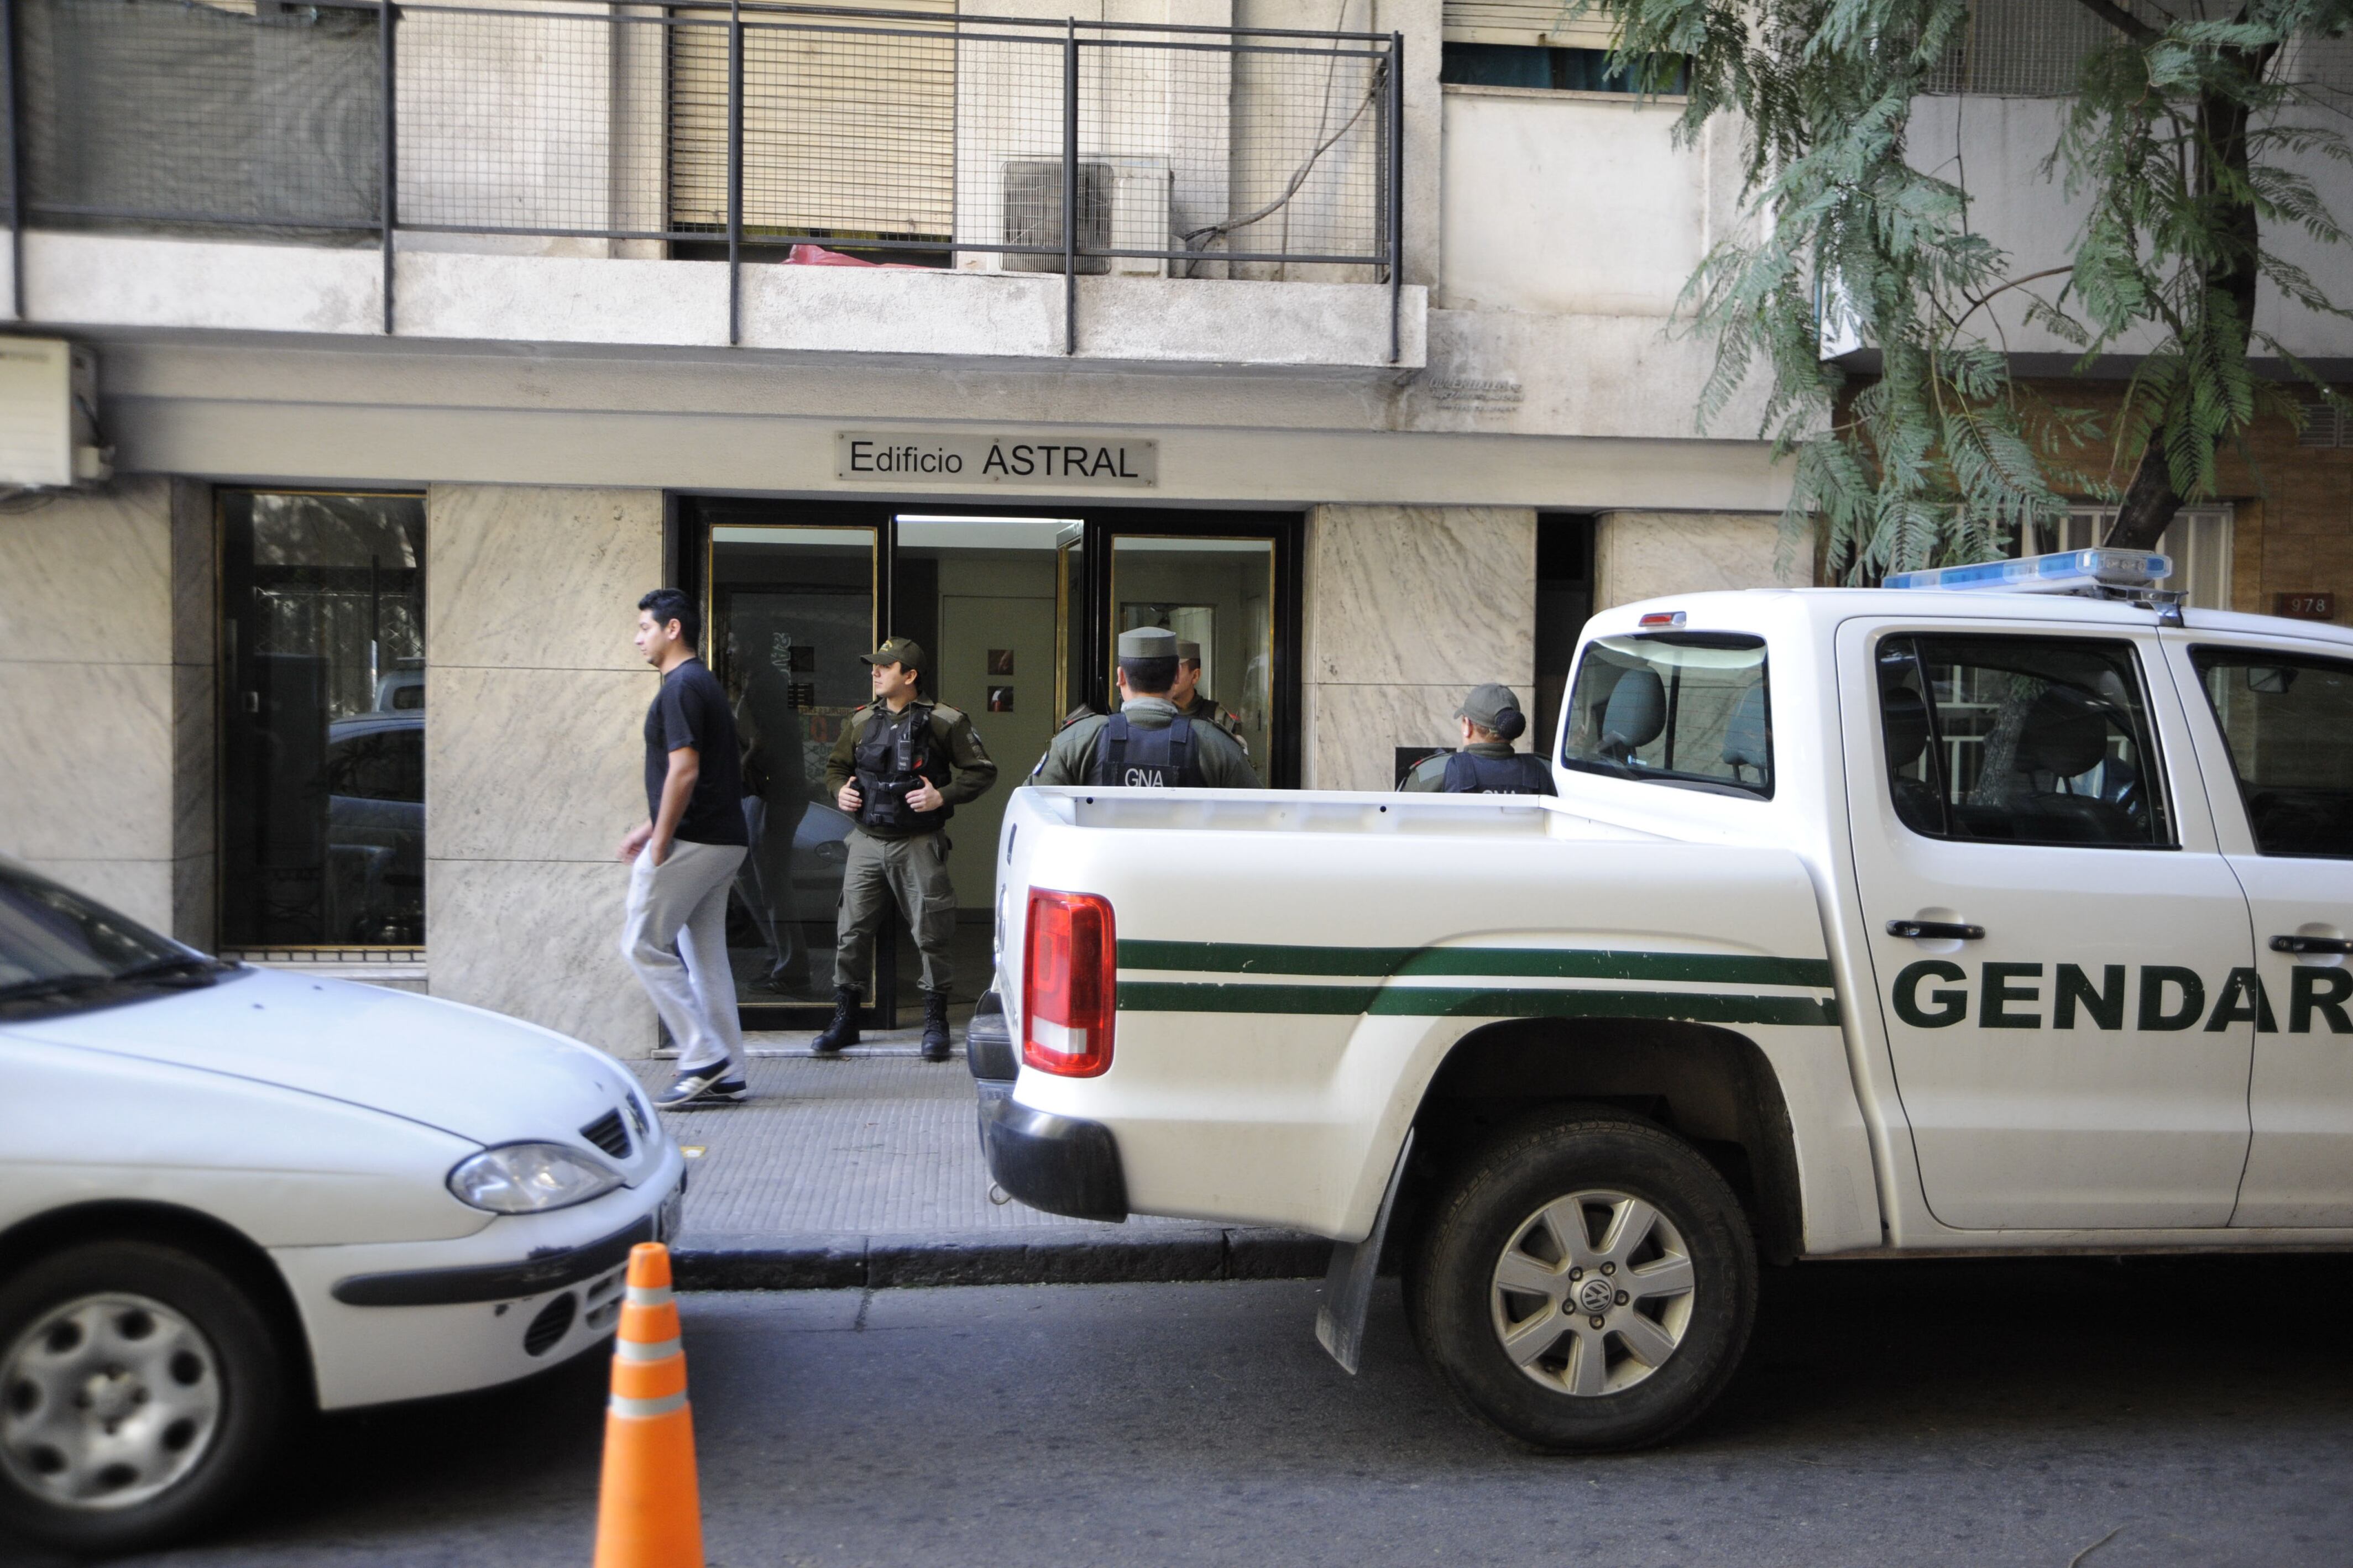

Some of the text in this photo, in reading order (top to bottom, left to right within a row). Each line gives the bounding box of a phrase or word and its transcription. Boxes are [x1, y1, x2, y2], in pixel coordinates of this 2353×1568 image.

[851, 441, 1138, 478] Edificio ASTRAL
[2291, 599, 2326, 612] 978
[1125, 768, 1164, 787] GNA
[1892, 959, 2353, 1034] GENDAR
